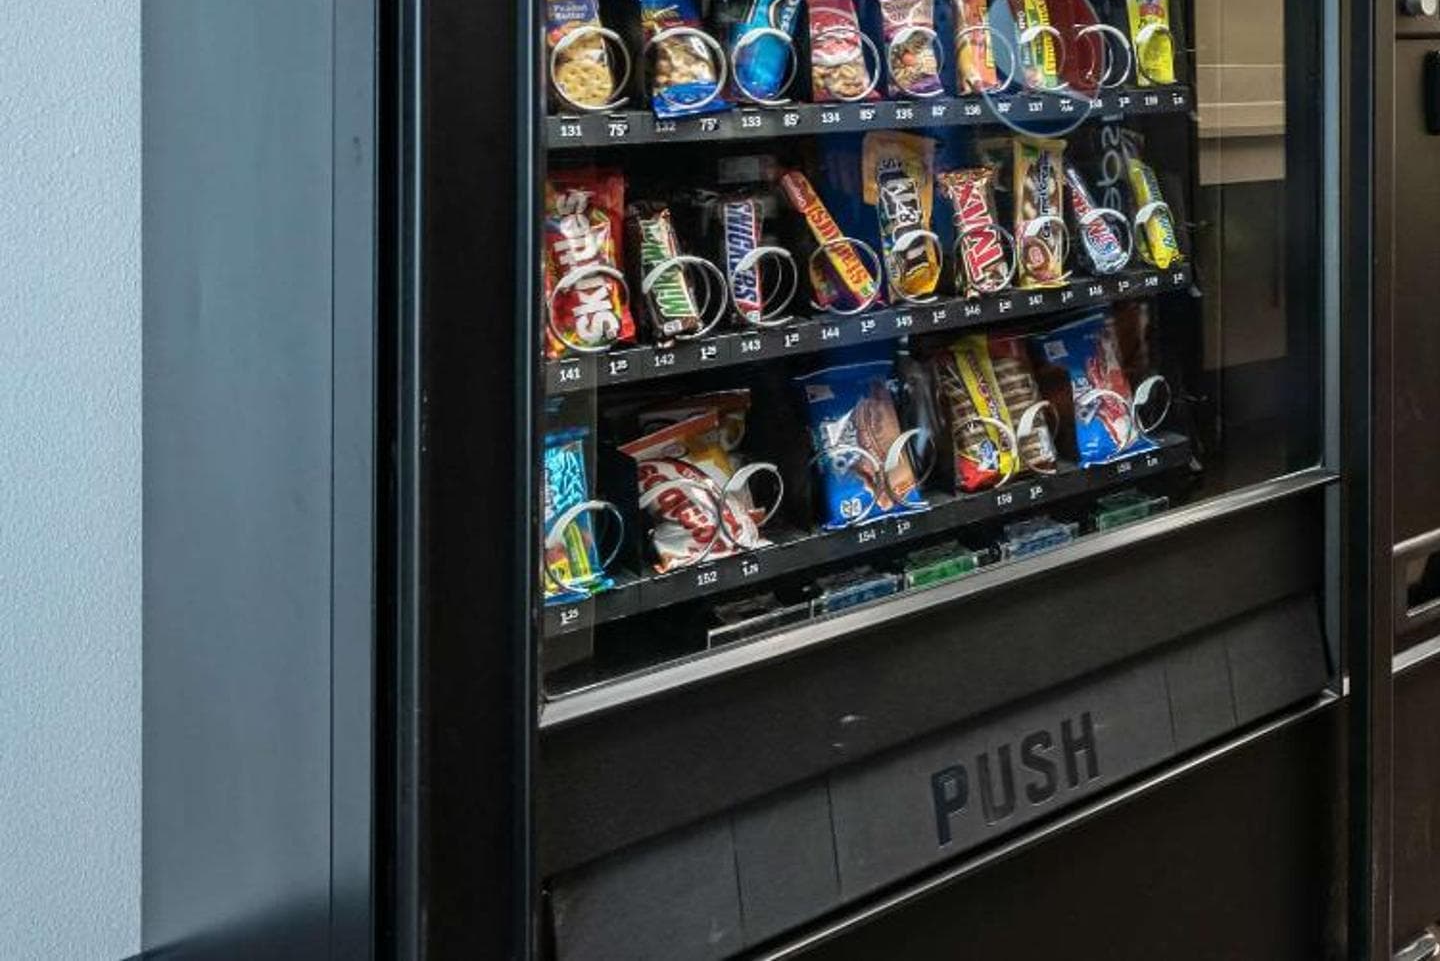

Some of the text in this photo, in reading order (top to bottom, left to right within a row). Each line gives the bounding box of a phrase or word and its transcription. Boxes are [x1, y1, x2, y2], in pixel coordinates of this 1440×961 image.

[742, 116, 762, 128] 133
[821, 111, 840, 123] 134
[560, 125, 582, 137] 131
[725, 200, 760, 303] SNICKRS
[554, 189, 620, 343] Skitles
[822, 327, 840, 340] 144
[741, 339, 761, 353] 143
[654, 353, 675, 367] 142
[560, 367, 582, 383] 141
[858, 528, 877, 543] 154
[697, 570, 718, 586] 152
[930, 711, 1101, 849] PUSH
